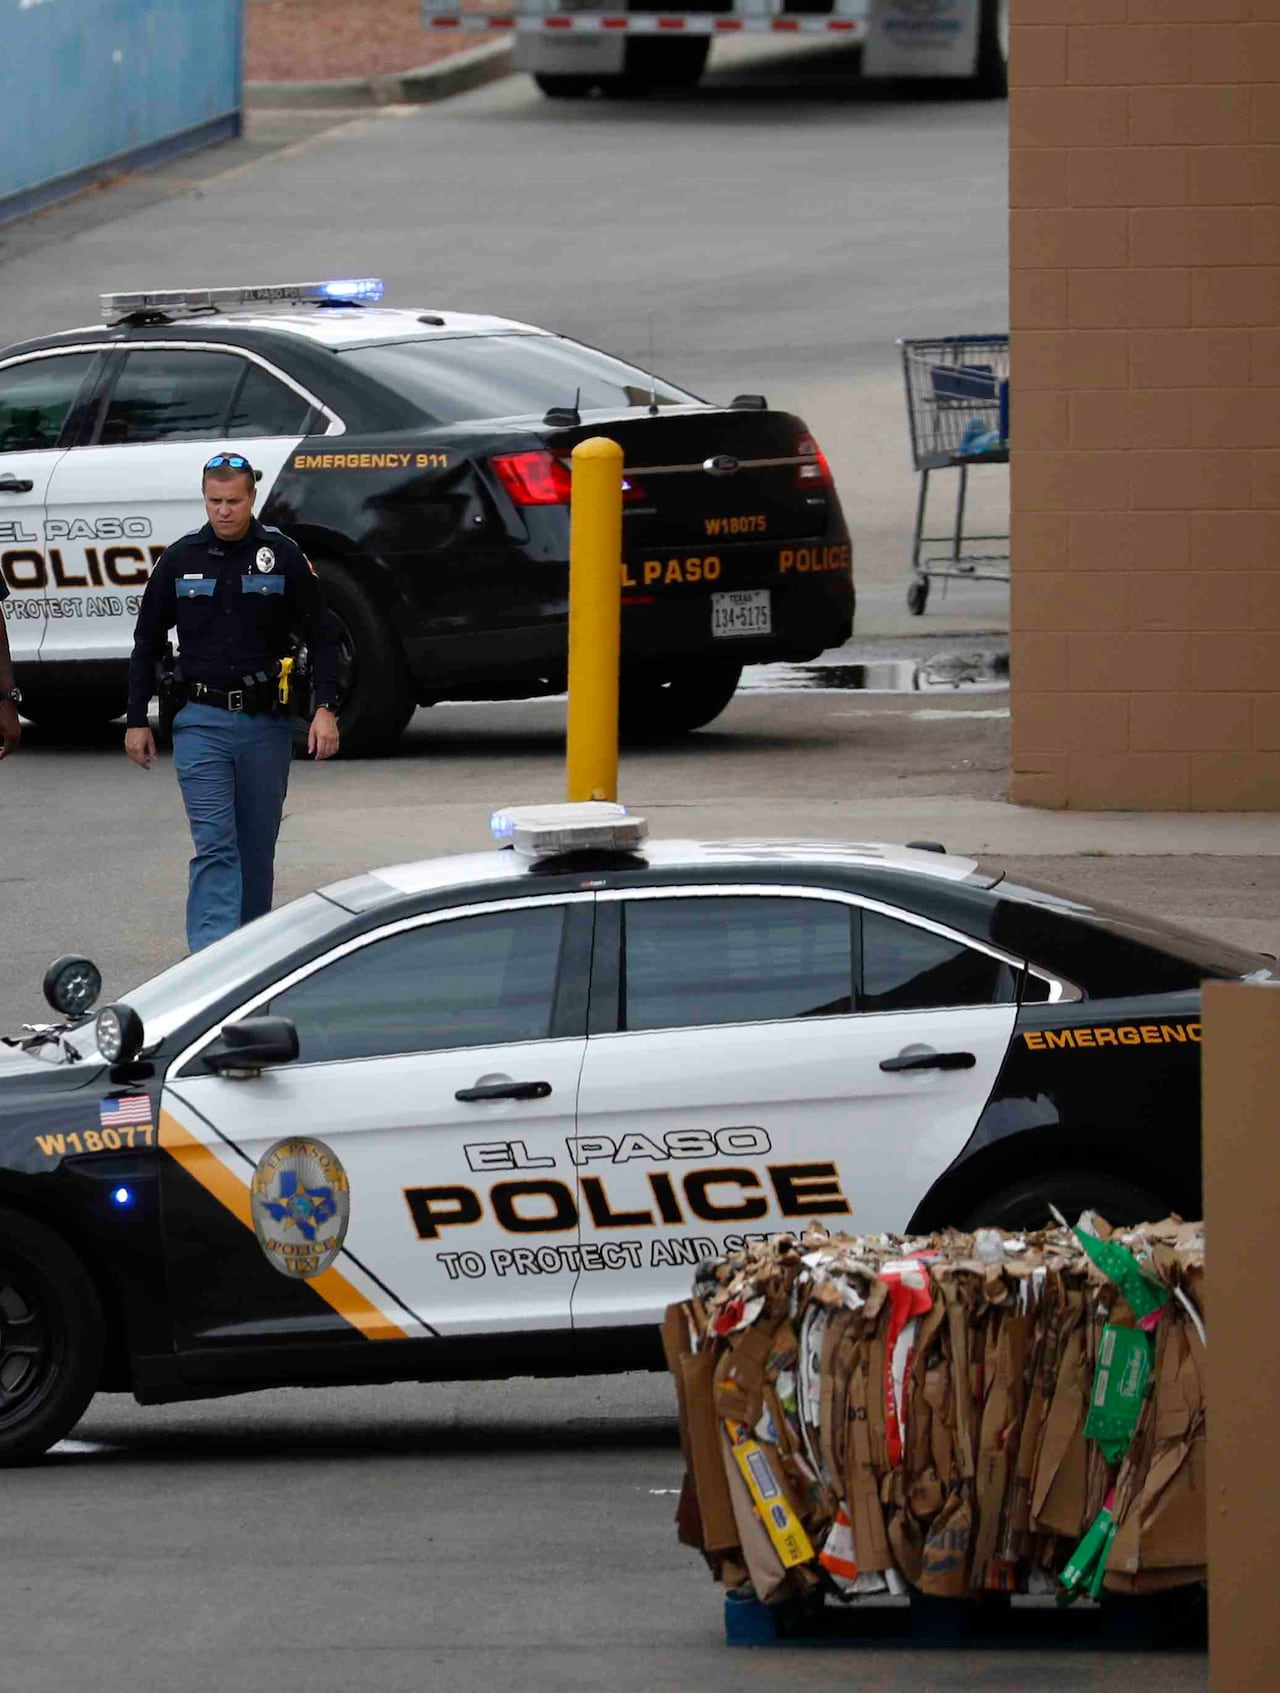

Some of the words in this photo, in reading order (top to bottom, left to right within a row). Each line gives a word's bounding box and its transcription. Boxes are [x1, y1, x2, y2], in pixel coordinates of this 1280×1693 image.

[244, 290, 254, 300] EL
[257, 289, 283, 299] PASO
[294, 453, 412, 469] EMERGENCY
[416, 454, 448, 468] 911
[43, 516, 152, 541] PASO
[705, 515, 767, 536] W18075
[1, 545, 167, 589] OLIC
[621, 564, 636, 586] L
[644, 556, 721, 584] PASO
[779, 545, 849, 572] POLICE
[0, 597, 83, 620] PROTECT
[87, 595, 124, 618] AND
[1023, 1023, 1202, 1050] EMERGENC
[36, 1125, 154, 1156] W18077
[464, 1141, 556, 1172] EL
[565, 1126, 772, 1167] PASO
[289, 1143, 331, 1168] PASO
[401, 1161, 853, 1240] POLICE
[273, 1240, 331, 1256] POLICE
[437, 1250, 486, 1280] TO
[491, 1241, 643, 1277] PROTECT
[650, 1236, 719, 1267] AND
